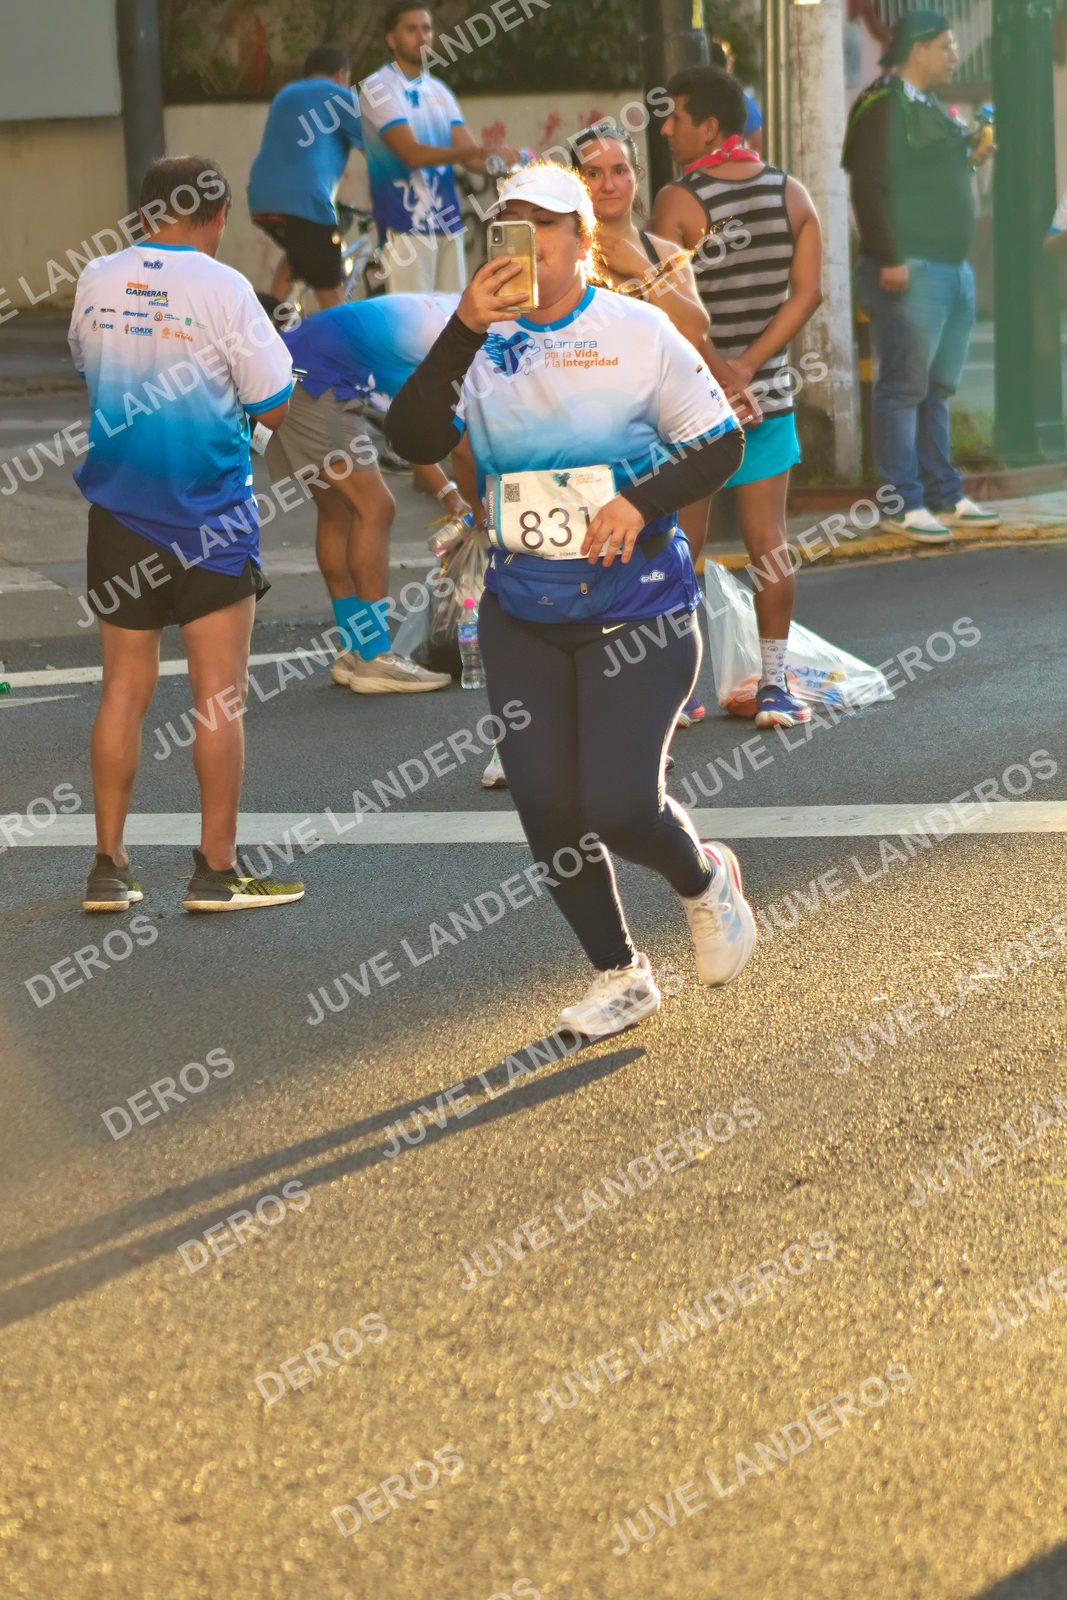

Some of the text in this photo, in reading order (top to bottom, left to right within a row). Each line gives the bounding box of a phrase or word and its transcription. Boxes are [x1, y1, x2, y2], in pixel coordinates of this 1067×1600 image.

[543, 339, 598, 349] Carrera
[544, 351, 559, 360] por
[575, 349, 599, 358] Vida
[552, 360, 561, 368] la
[563, 357, 619, 369] Integridad
